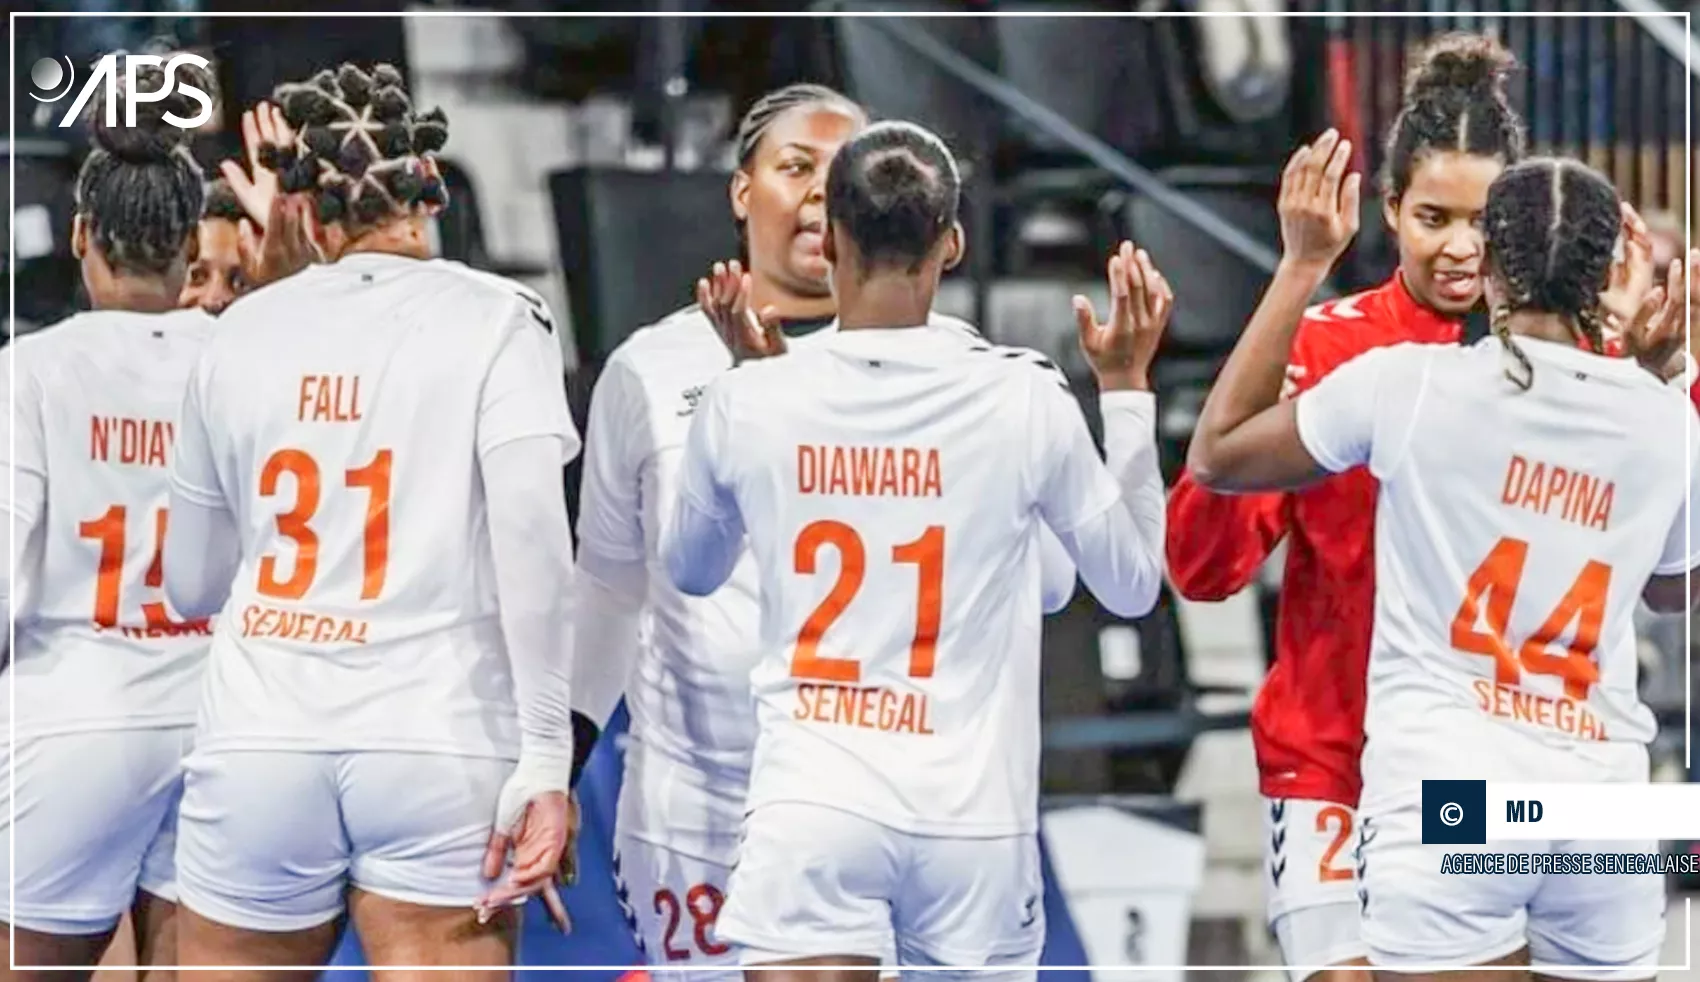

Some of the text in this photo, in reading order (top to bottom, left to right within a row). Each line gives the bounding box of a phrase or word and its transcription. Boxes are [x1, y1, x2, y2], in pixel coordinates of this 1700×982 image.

[298, 376, 362, 422] FALL
[797, 445, 942, 497] DIAWARA
[1502, 455, 1616, 531] DAPINA
[256, 449, 393, 601] 31
[242, 604, 368, 644] SENEGAL
[790, 519, 946, 682] 21
[1450, 536, 1613, 701] 44
[793, 682, 935, 735] SENEGAL
[653, 883, 731, 961] 28
